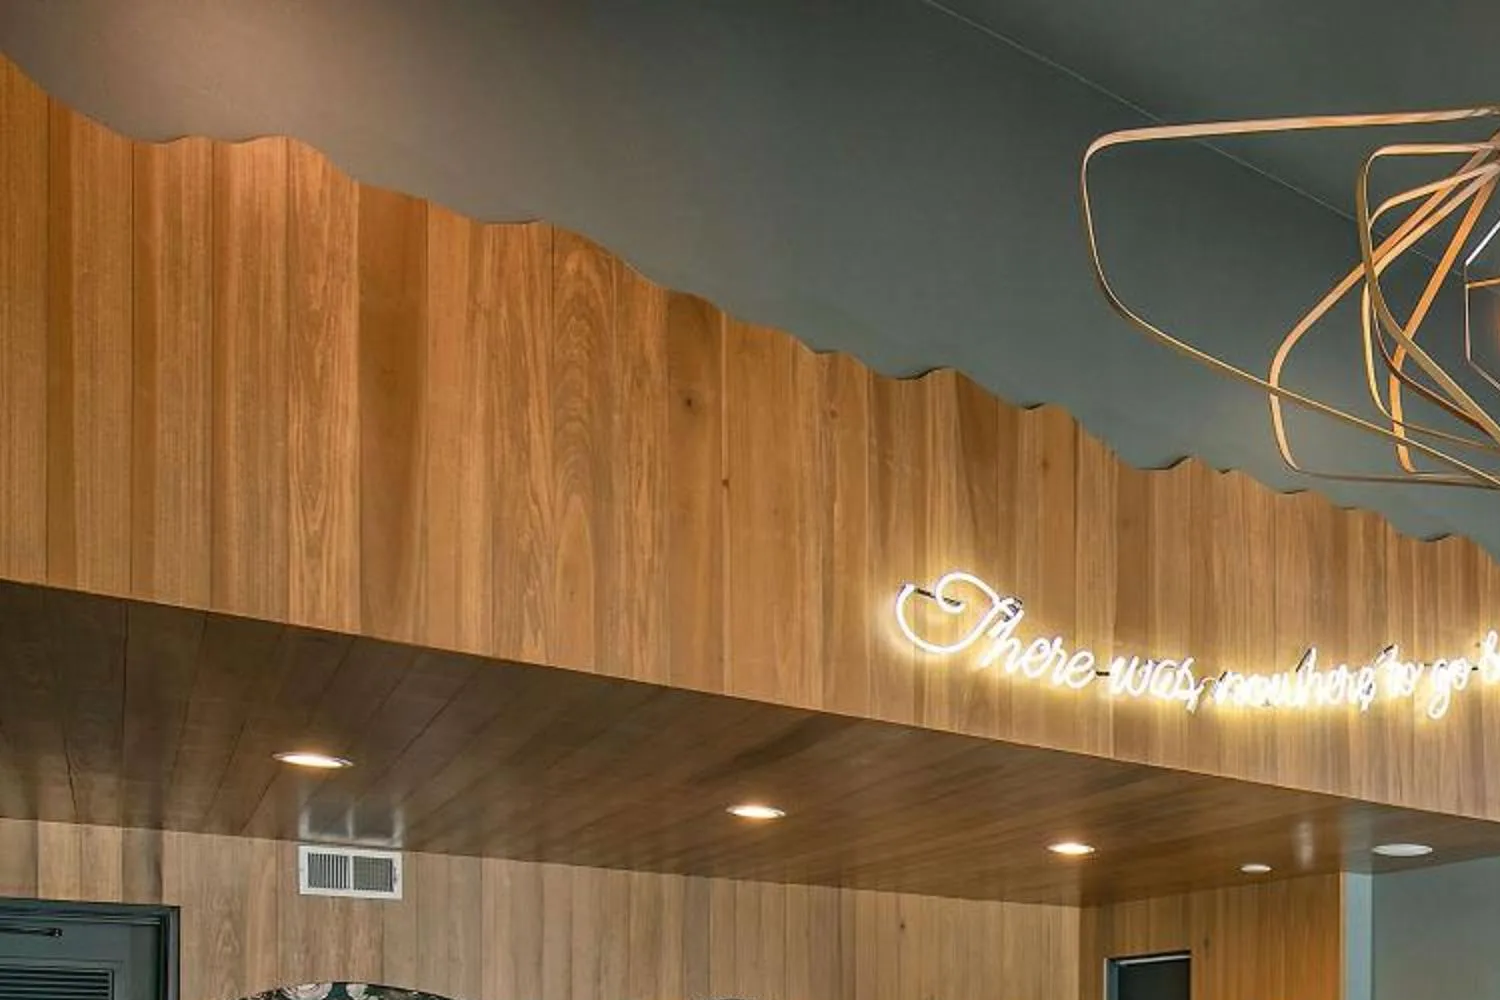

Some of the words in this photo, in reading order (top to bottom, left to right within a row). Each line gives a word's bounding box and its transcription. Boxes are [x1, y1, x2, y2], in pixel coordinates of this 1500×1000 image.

[895, 571, 1096, 689] There
[1106, 655, 1204, 713] was
[1425, 657, 1470, 719] go
